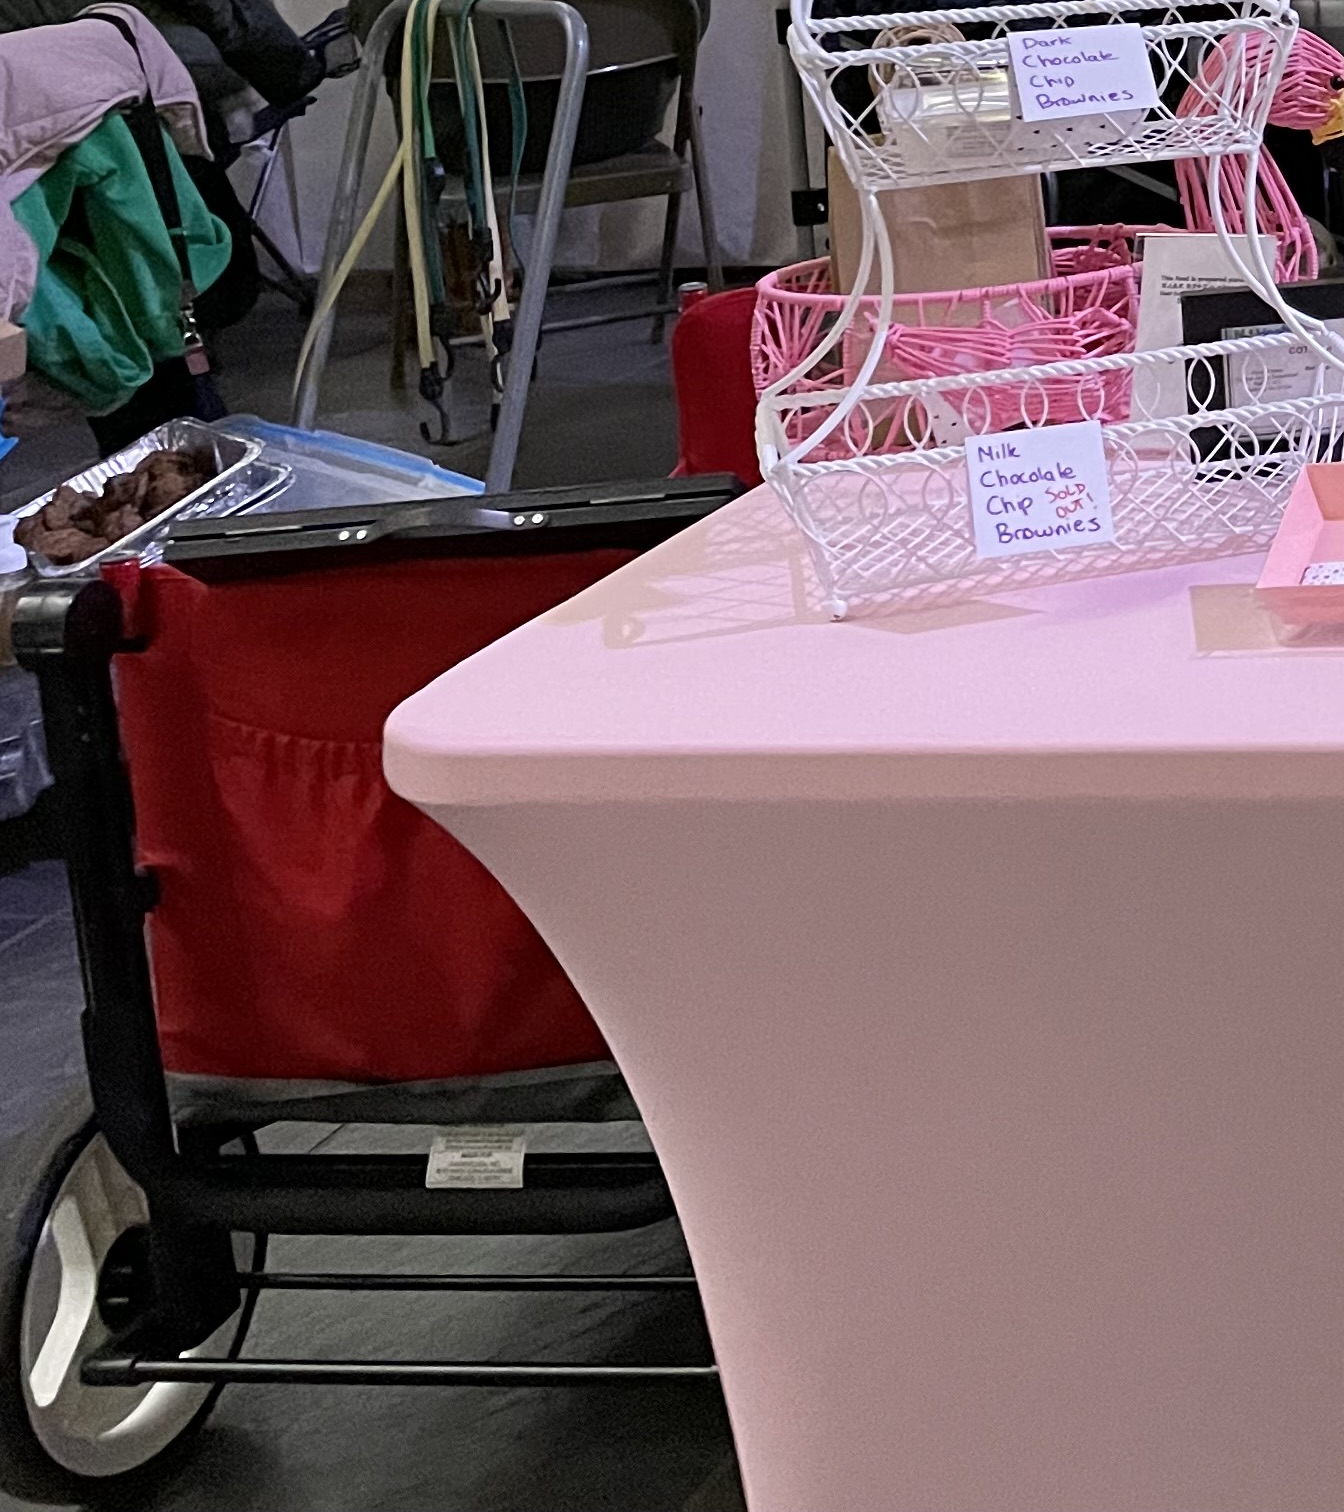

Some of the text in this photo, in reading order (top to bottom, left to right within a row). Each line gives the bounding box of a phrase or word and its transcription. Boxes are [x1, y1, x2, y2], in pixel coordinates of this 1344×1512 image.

[1023, 36, 1072, 50] Dark
[1022, 51, 1120, 68] Chocolate
[1030, 75, 1075, 88] Chip
[1036, 90, 1134, 110] Brownies
[977, 442, 1021, 463] Milk
[979, 461, 1077, 488] Chocolate
[1044, 483, 1086, 504] SOLD
[986, 494, 1033, 516] Chip
[995, 517, 1102, 544] Brownies
